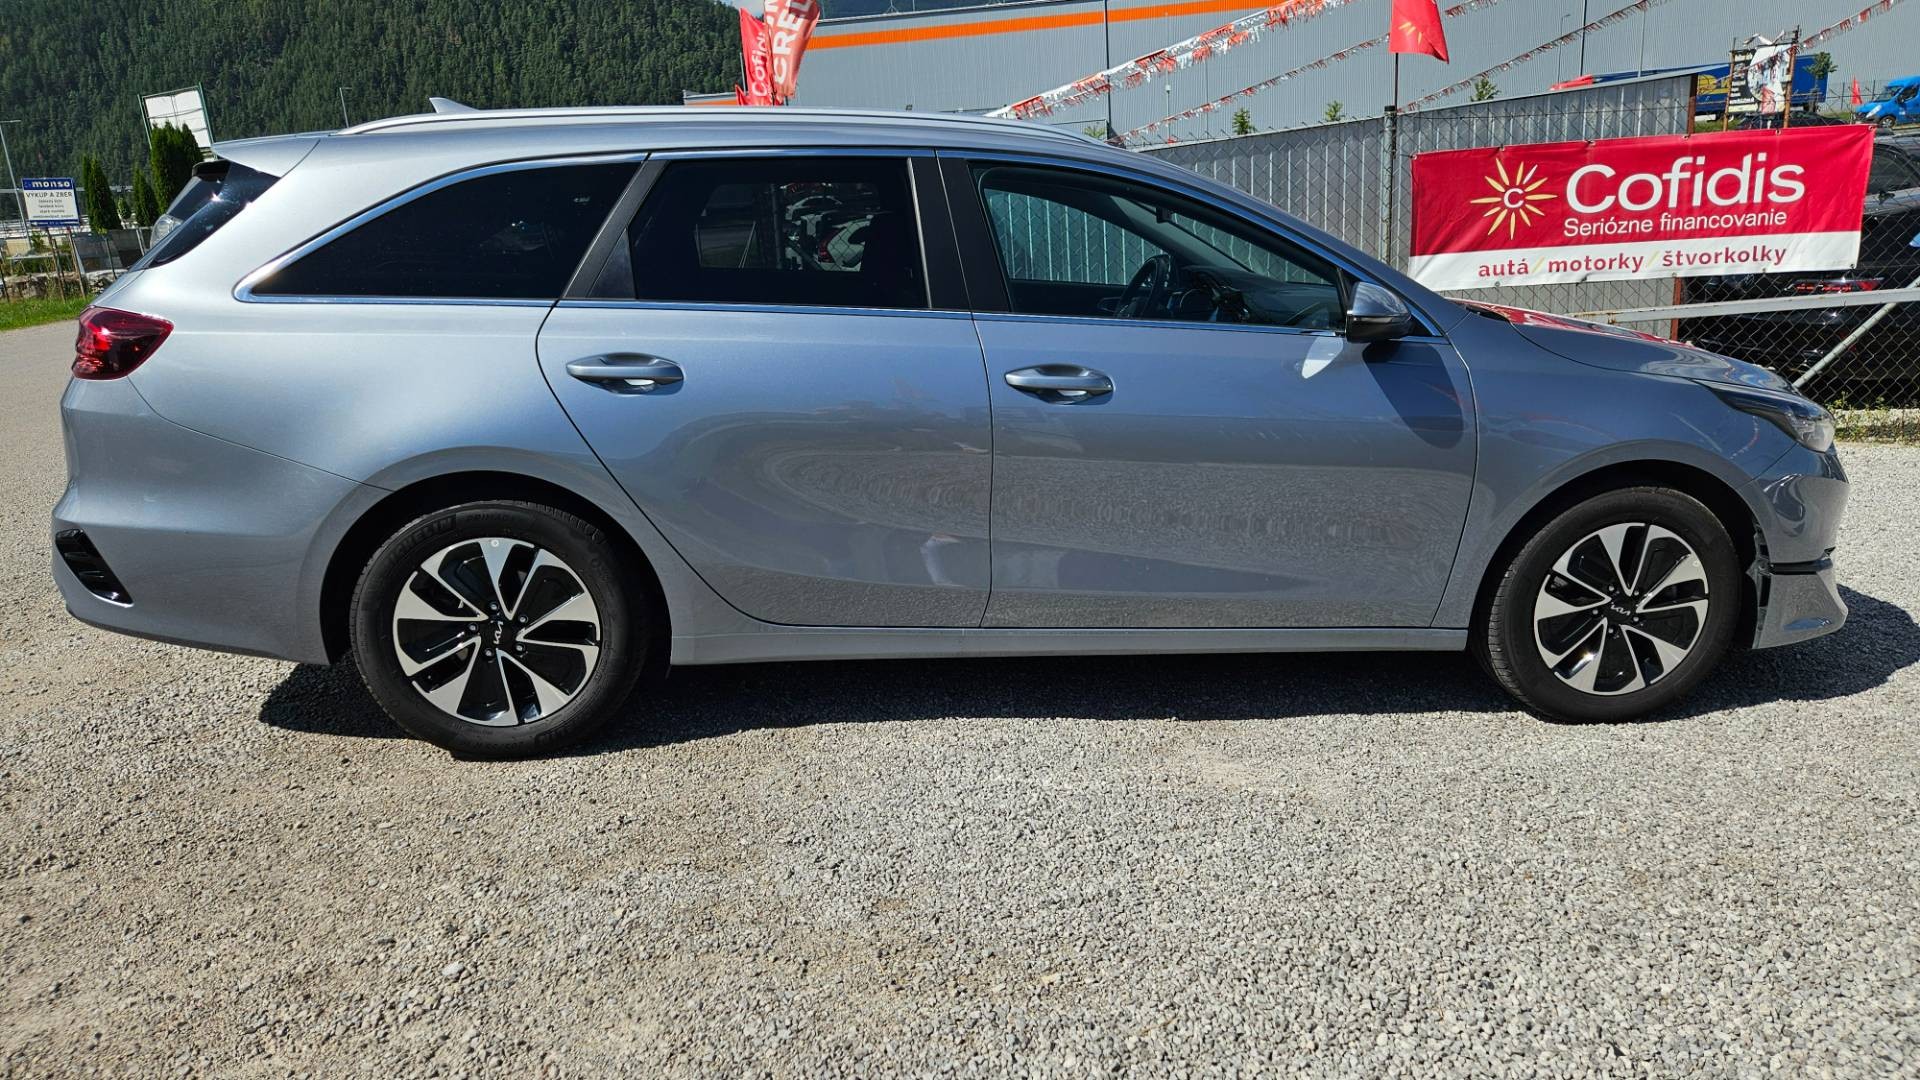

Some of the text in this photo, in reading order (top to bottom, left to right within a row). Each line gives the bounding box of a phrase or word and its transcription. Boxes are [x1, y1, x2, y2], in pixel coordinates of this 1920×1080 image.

[1503, 187, 1525, 209] C
[1566, 152, 1806, 214] Cofidis
[1564, 208, 1787, 237] Seriózne financovanie
[1478, 245, 1787, 277] autá motorky štvorkolky
